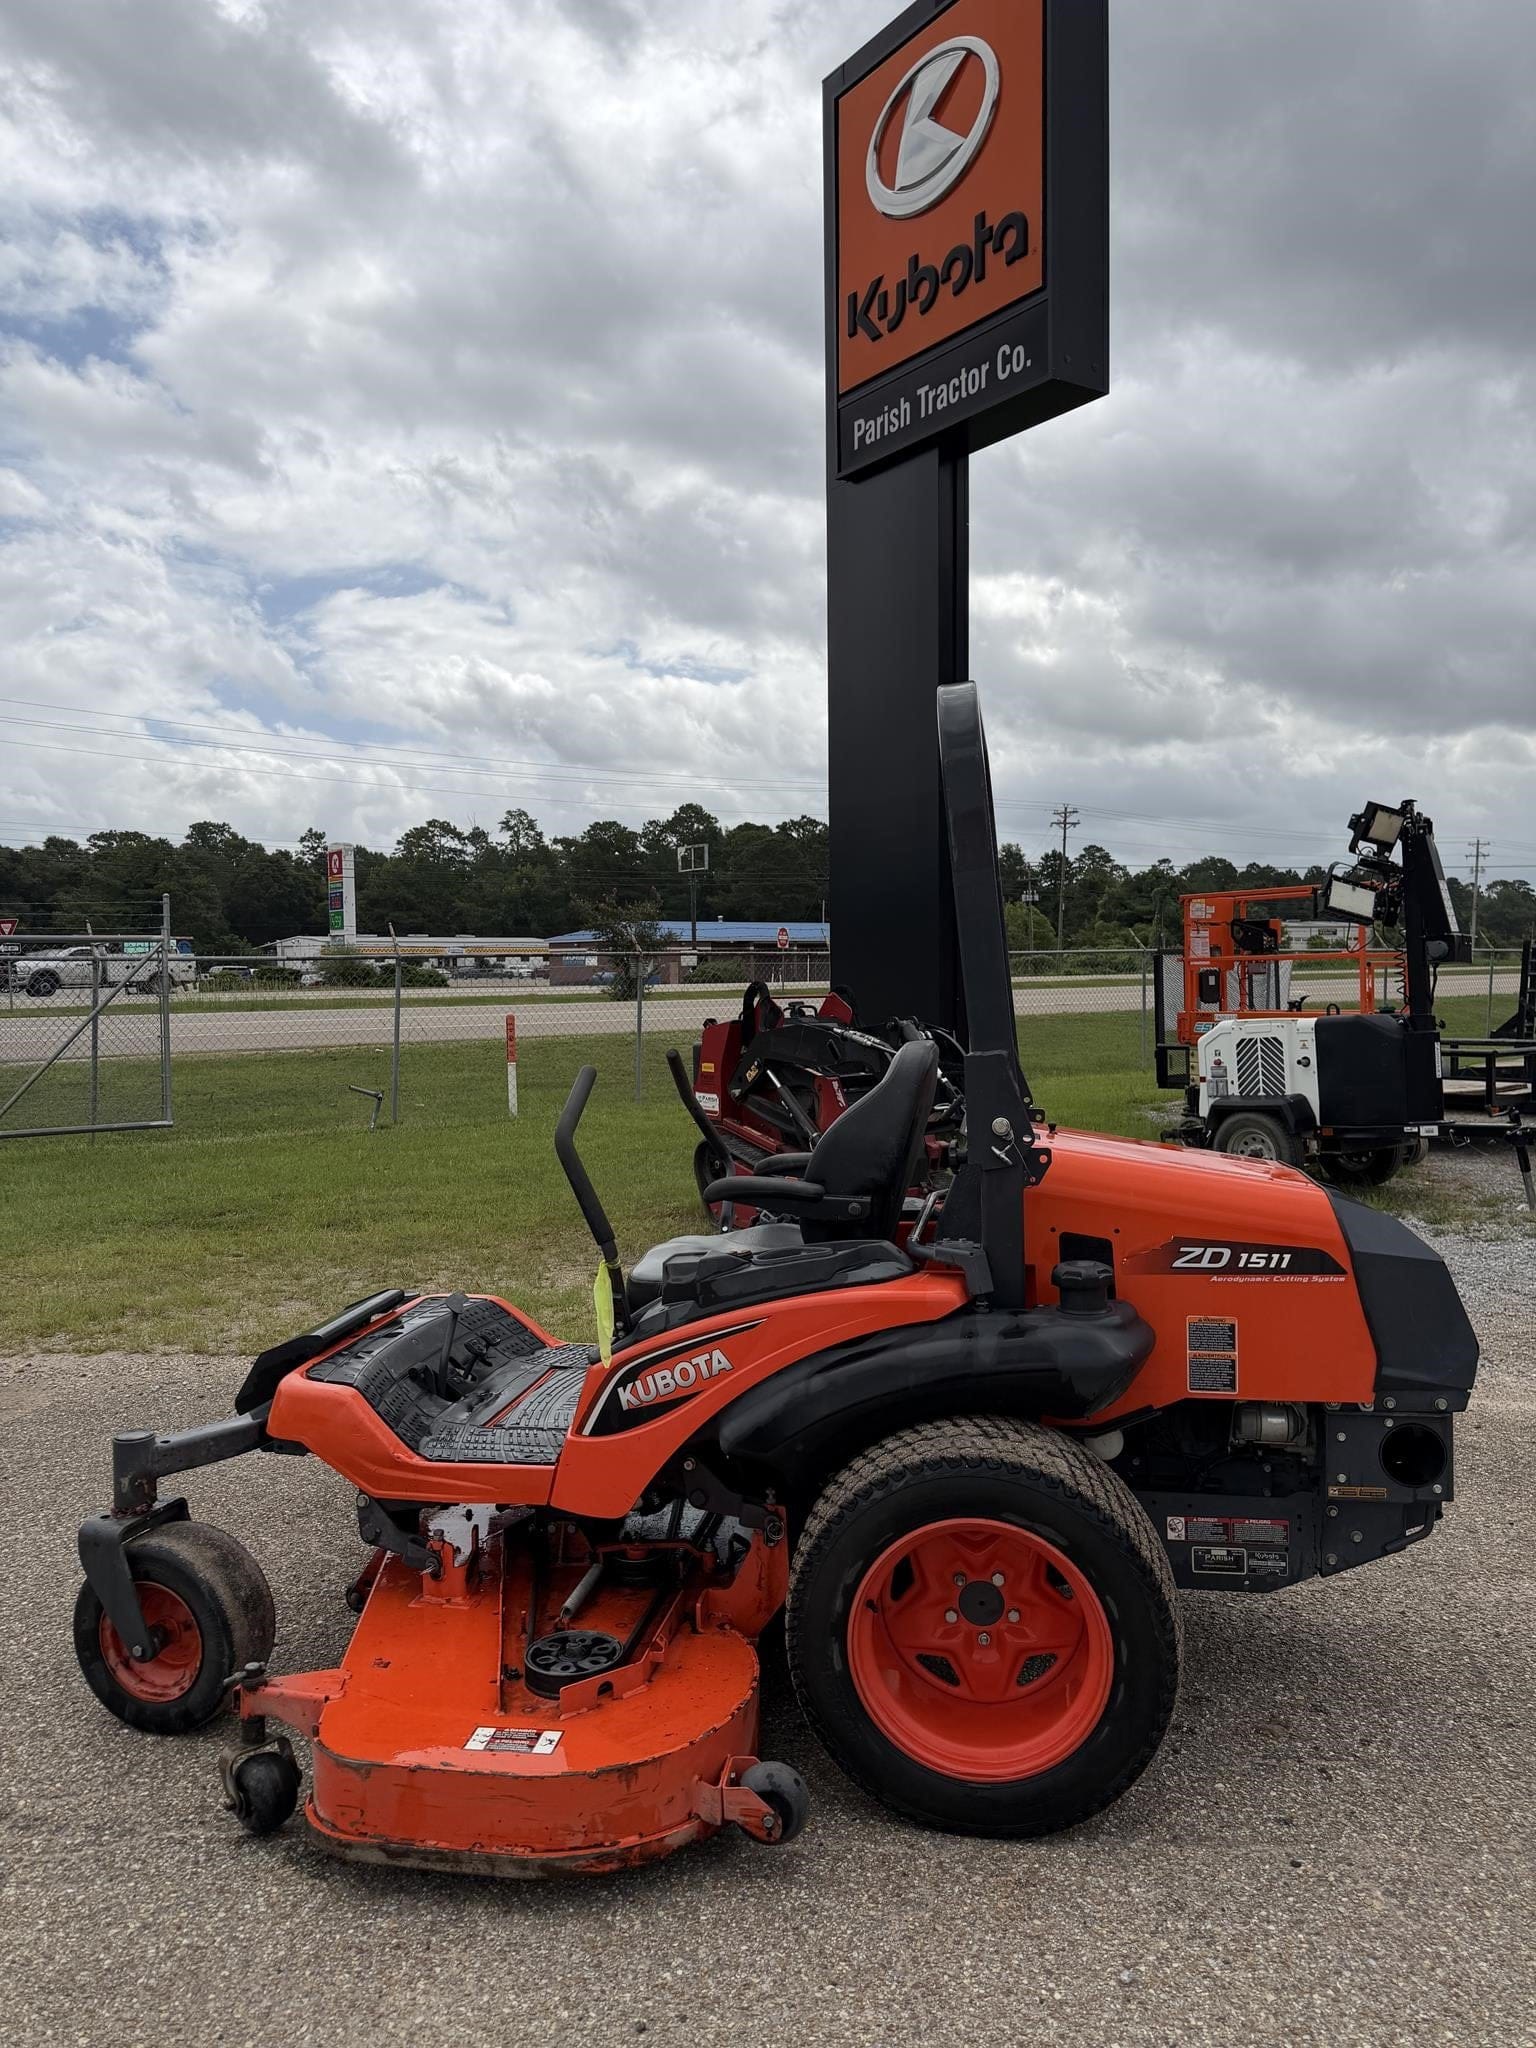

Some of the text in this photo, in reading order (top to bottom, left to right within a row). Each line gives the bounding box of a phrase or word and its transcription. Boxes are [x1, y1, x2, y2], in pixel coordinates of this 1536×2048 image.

[847, 210, 1029, 343] Kubota
[854, 343, 1032, 451] Parish Tractor Co.
[1172, 1247, 1292, 1269] ZD 1511
[1209, 1275, 1346, 1284] Aerodynamic Cutting System
[617, 1348, 734, 1411] KUBOTA
